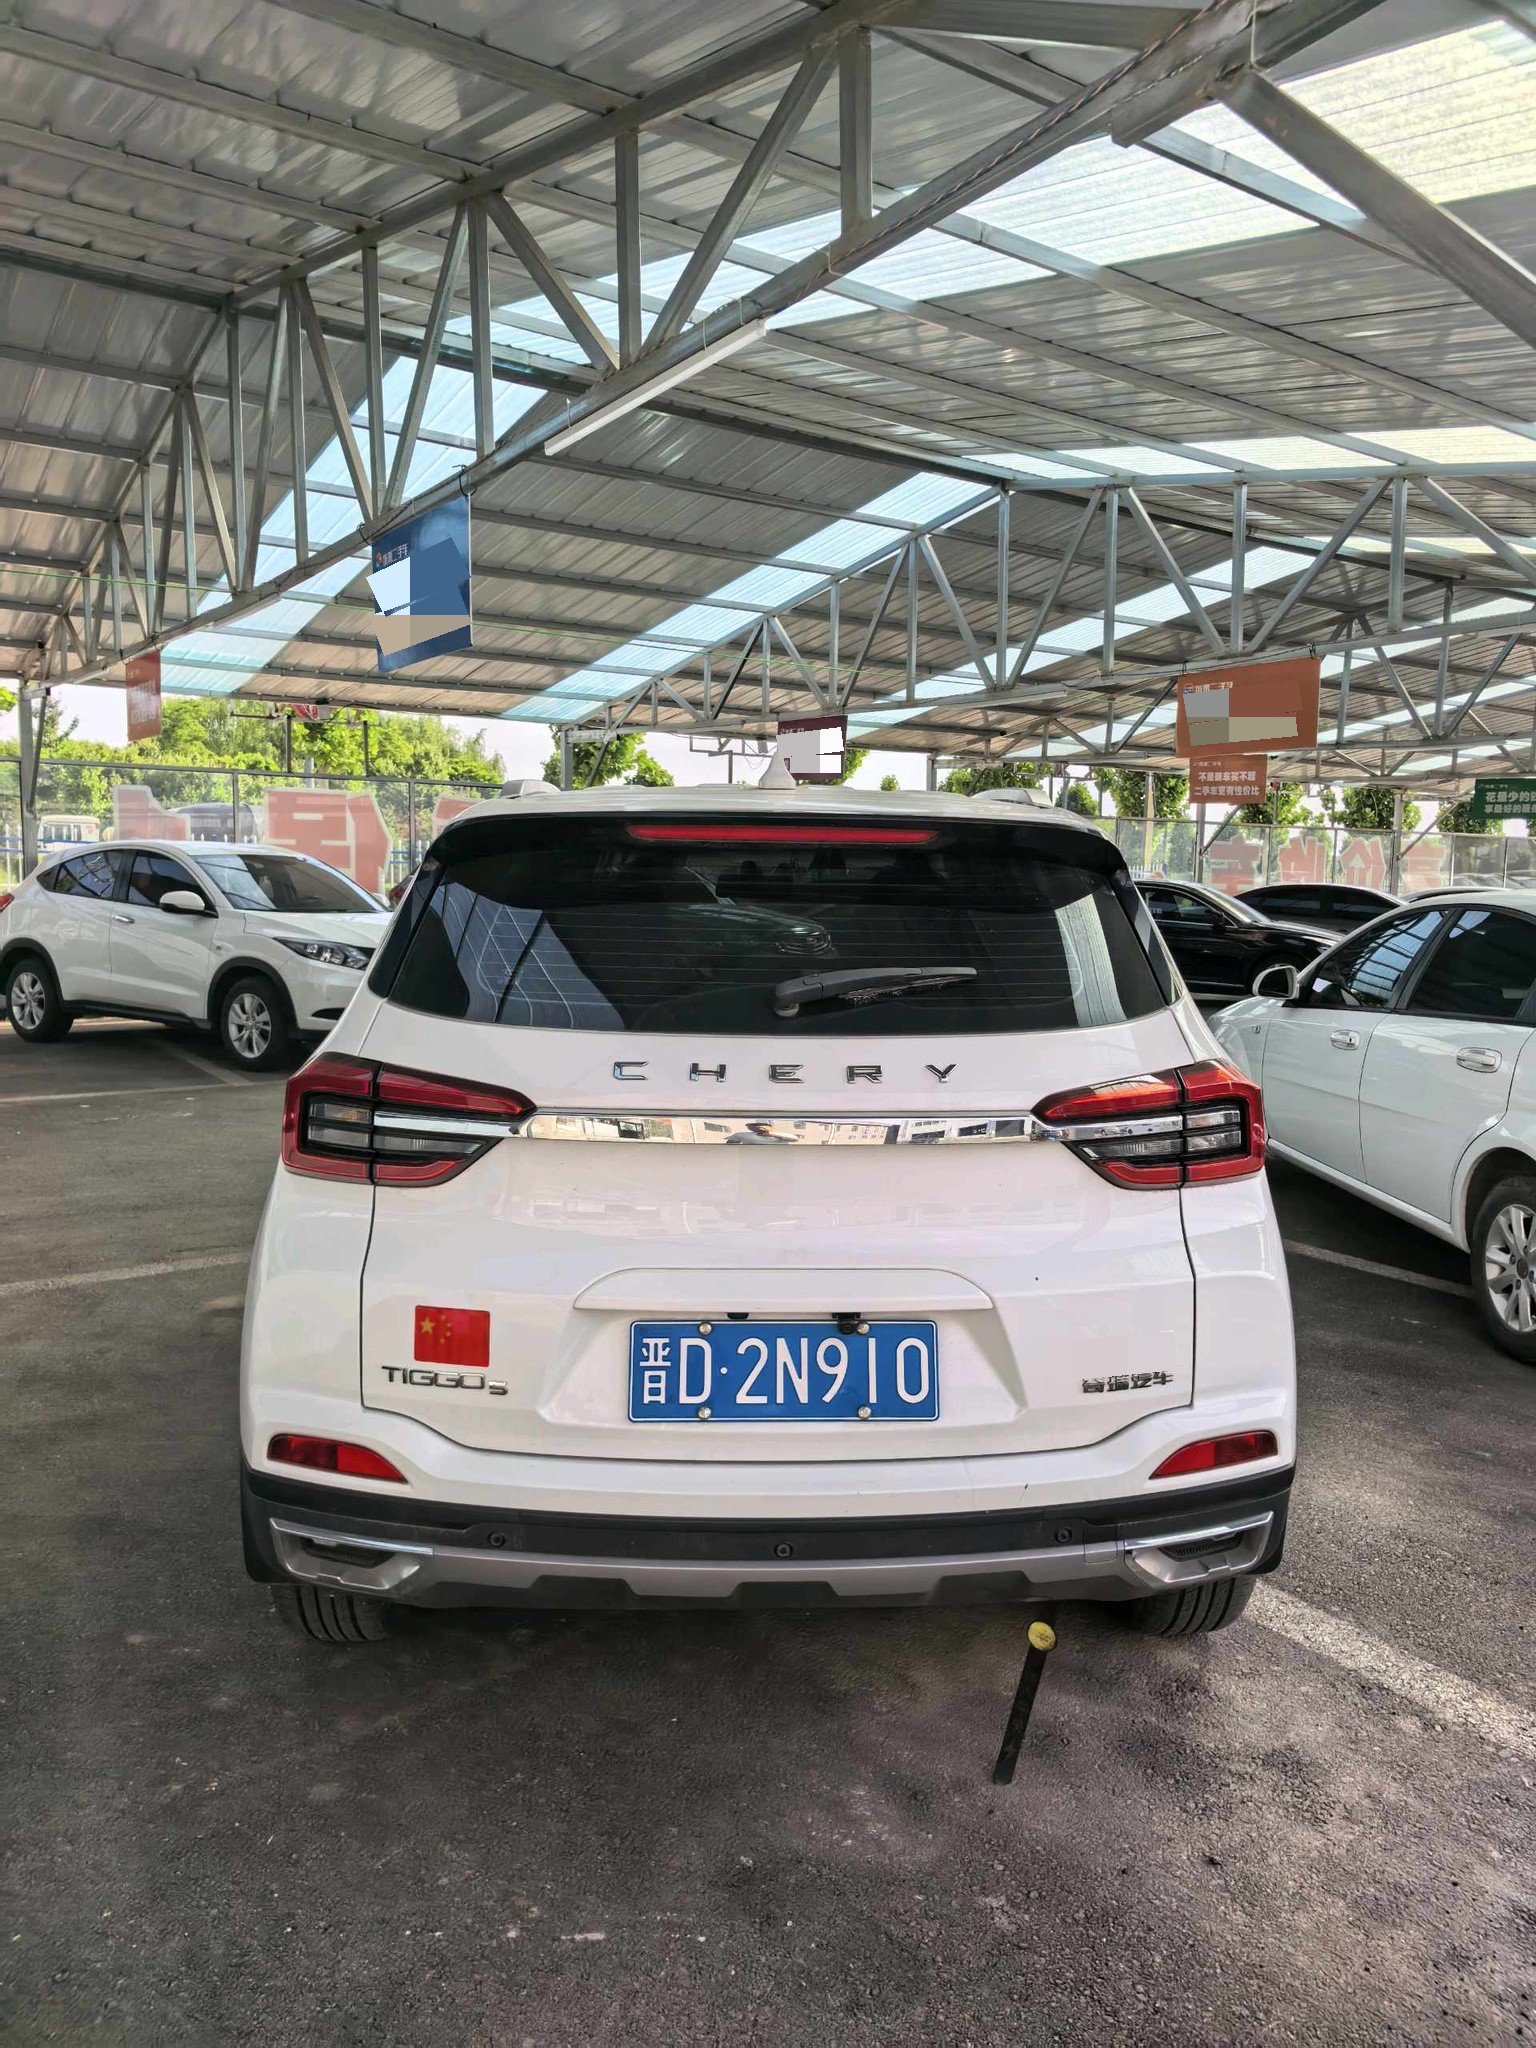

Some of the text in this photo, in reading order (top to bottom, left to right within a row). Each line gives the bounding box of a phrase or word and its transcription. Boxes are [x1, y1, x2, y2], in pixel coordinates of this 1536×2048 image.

[1194, 786, 1260, 796] 二手车更有性价比
[613, 1061, 958, 1083] CHERY
